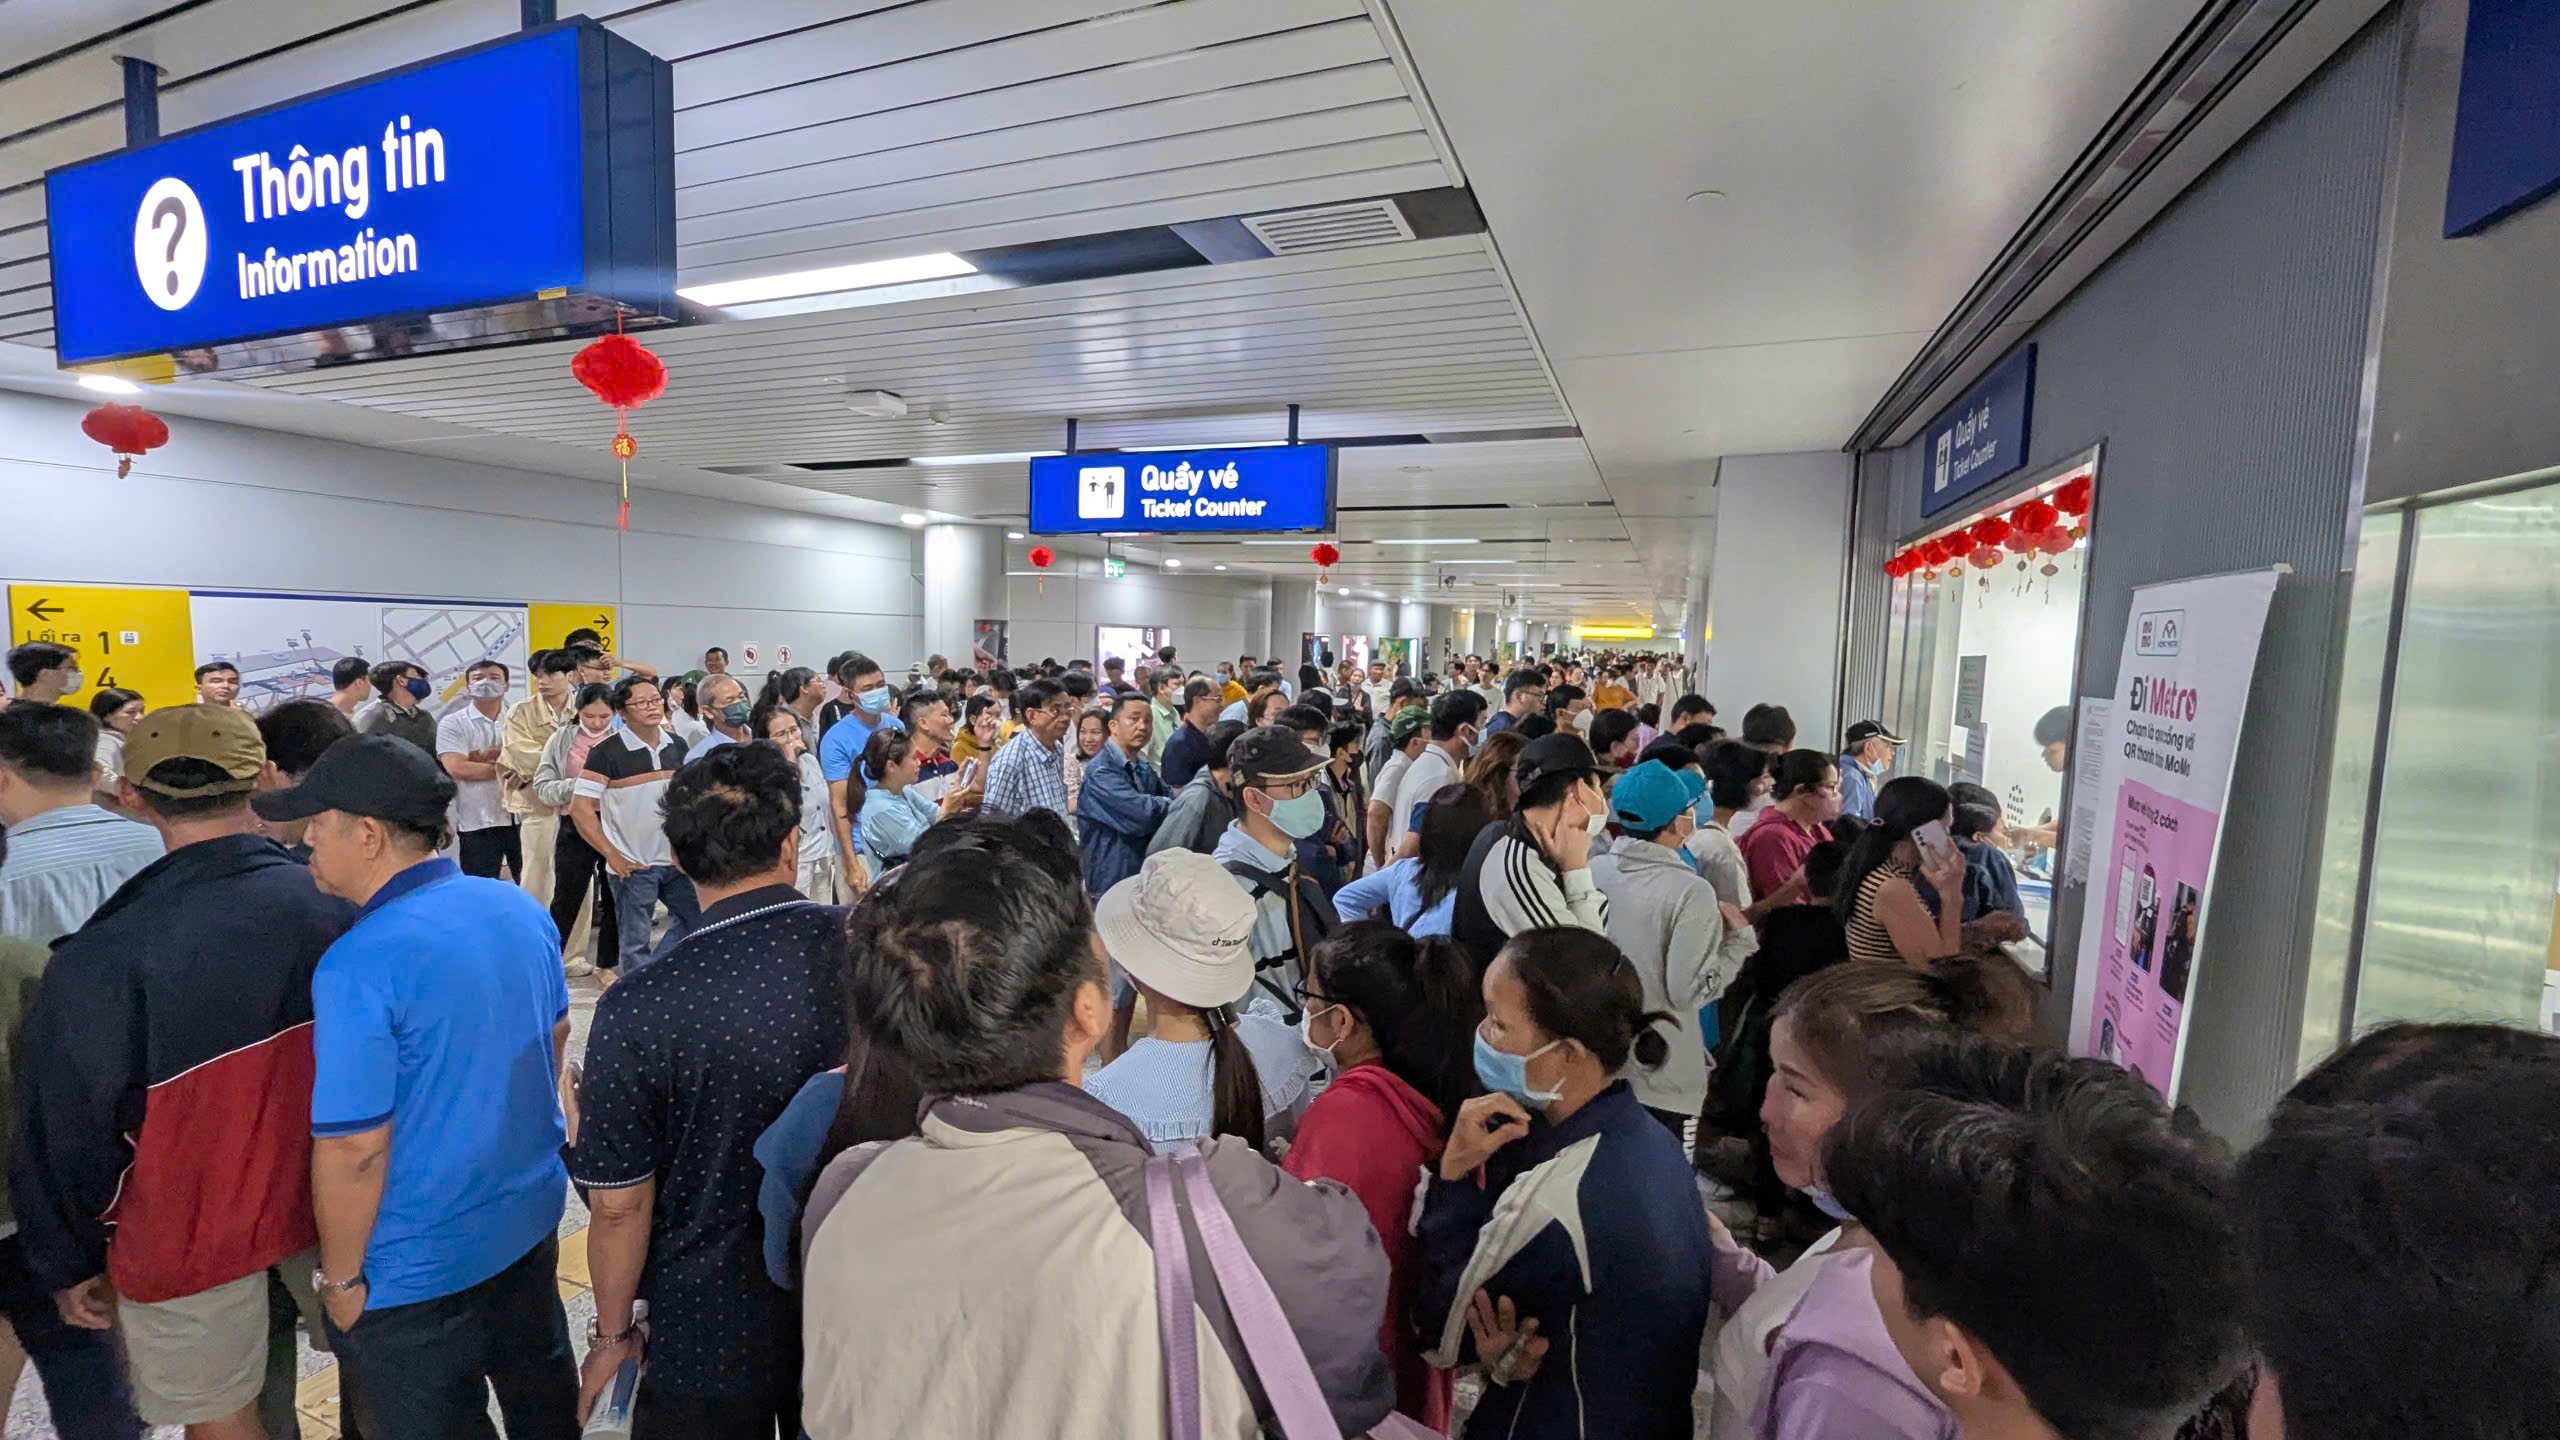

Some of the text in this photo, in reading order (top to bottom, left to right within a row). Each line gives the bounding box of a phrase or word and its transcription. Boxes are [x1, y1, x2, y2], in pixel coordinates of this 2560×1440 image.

[232, 115, 445, 223] Thông tin
[238, 228, 417, 299] Information
[1978, 397, 1990, 433] vé
[1953, 440, 1998, 481] Ticket Counter
[1208, 461, 1239, 489] vé
[1140, 497, 1267, 518] Ticket Counter
[62, 632, 81, 643] ra
[98, 631, 110, 655] 1
[602, 636, 611, 652] 2
[96, 666, 117, 688] 4
[2130, 674, 2149, 713] Đi
[2149, 677, 2198, 723] Metro
[2124, 742, 2137, 759] QR
[2153, 809, 2160, 825] 2
